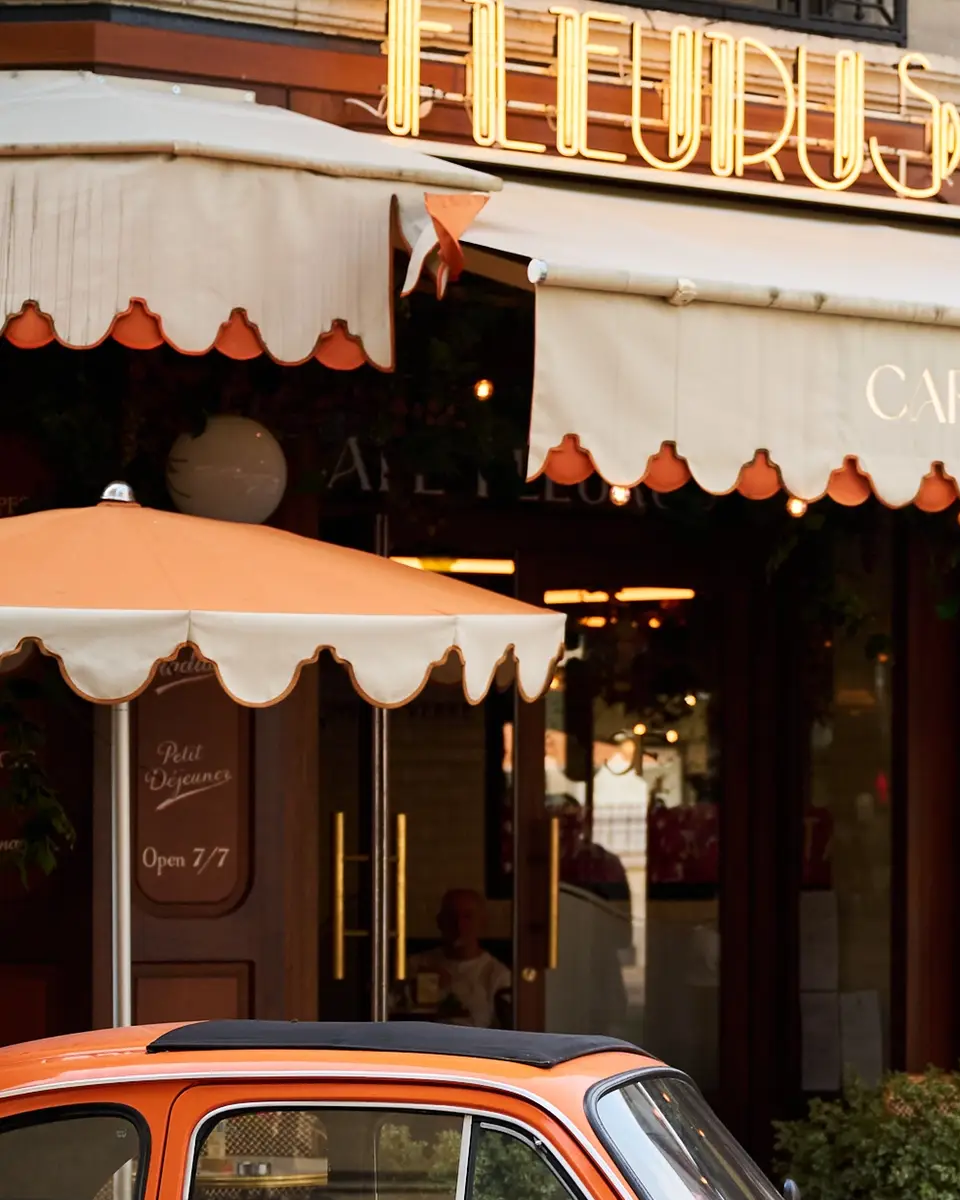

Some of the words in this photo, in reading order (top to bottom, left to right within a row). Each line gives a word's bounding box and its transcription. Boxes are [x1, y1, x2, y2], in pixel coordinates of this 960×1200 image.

[156, 740, 204, 764] Petit
[145, 766, 233, 796] Déjeuner
[141, 845, 187, 876] Open
[191, 845, 231, 875] 7/7
